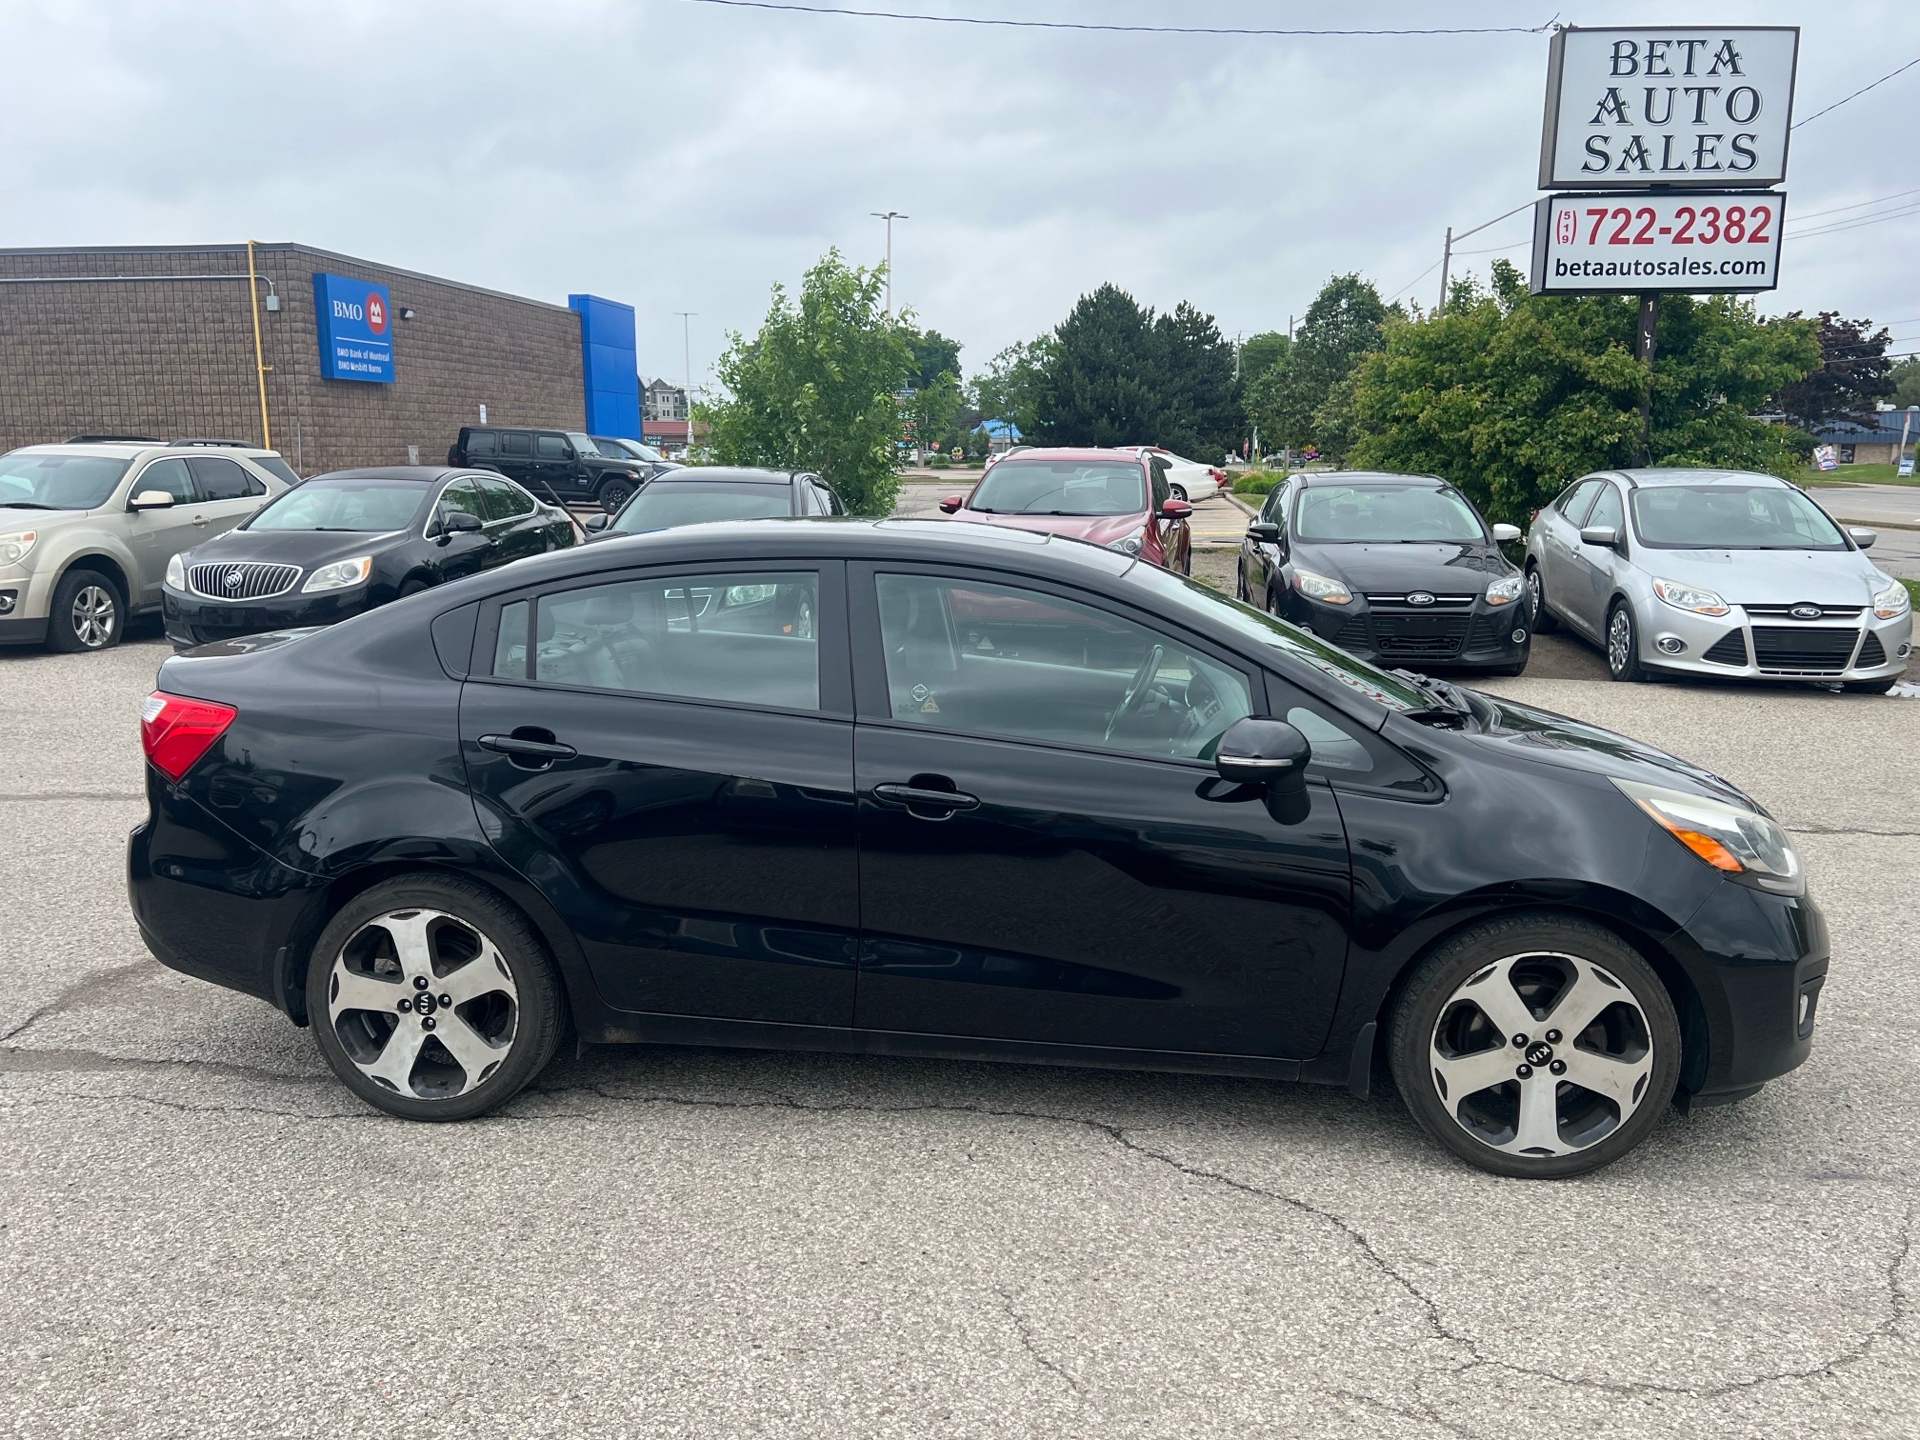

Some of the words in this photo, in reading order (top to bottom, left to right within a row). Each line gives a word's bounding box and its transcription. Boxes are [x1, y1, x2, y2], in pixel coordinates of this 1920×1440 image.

[1610, 39, 1746, 77] BETA
[1588, 86, 1763, 126] AUTO
[1581, 133, 1758, 173] SALES
[1586, 205, 1772, 245] 722-2382
[1555, 257, 1766, 277] betaautosales.com
[333, 300, 362, 321] BMO
[336, 347, 349, 357] BMO
[350, 349, 362, 359] Bank
[363, 350, 369, 359] of
[369, 351, 390, 362] Montreal
[338, 360, 350, 370] BMO
[420, 994, 429, 1014] KIA
[1528, 1046, 1550, 1063] KIA
